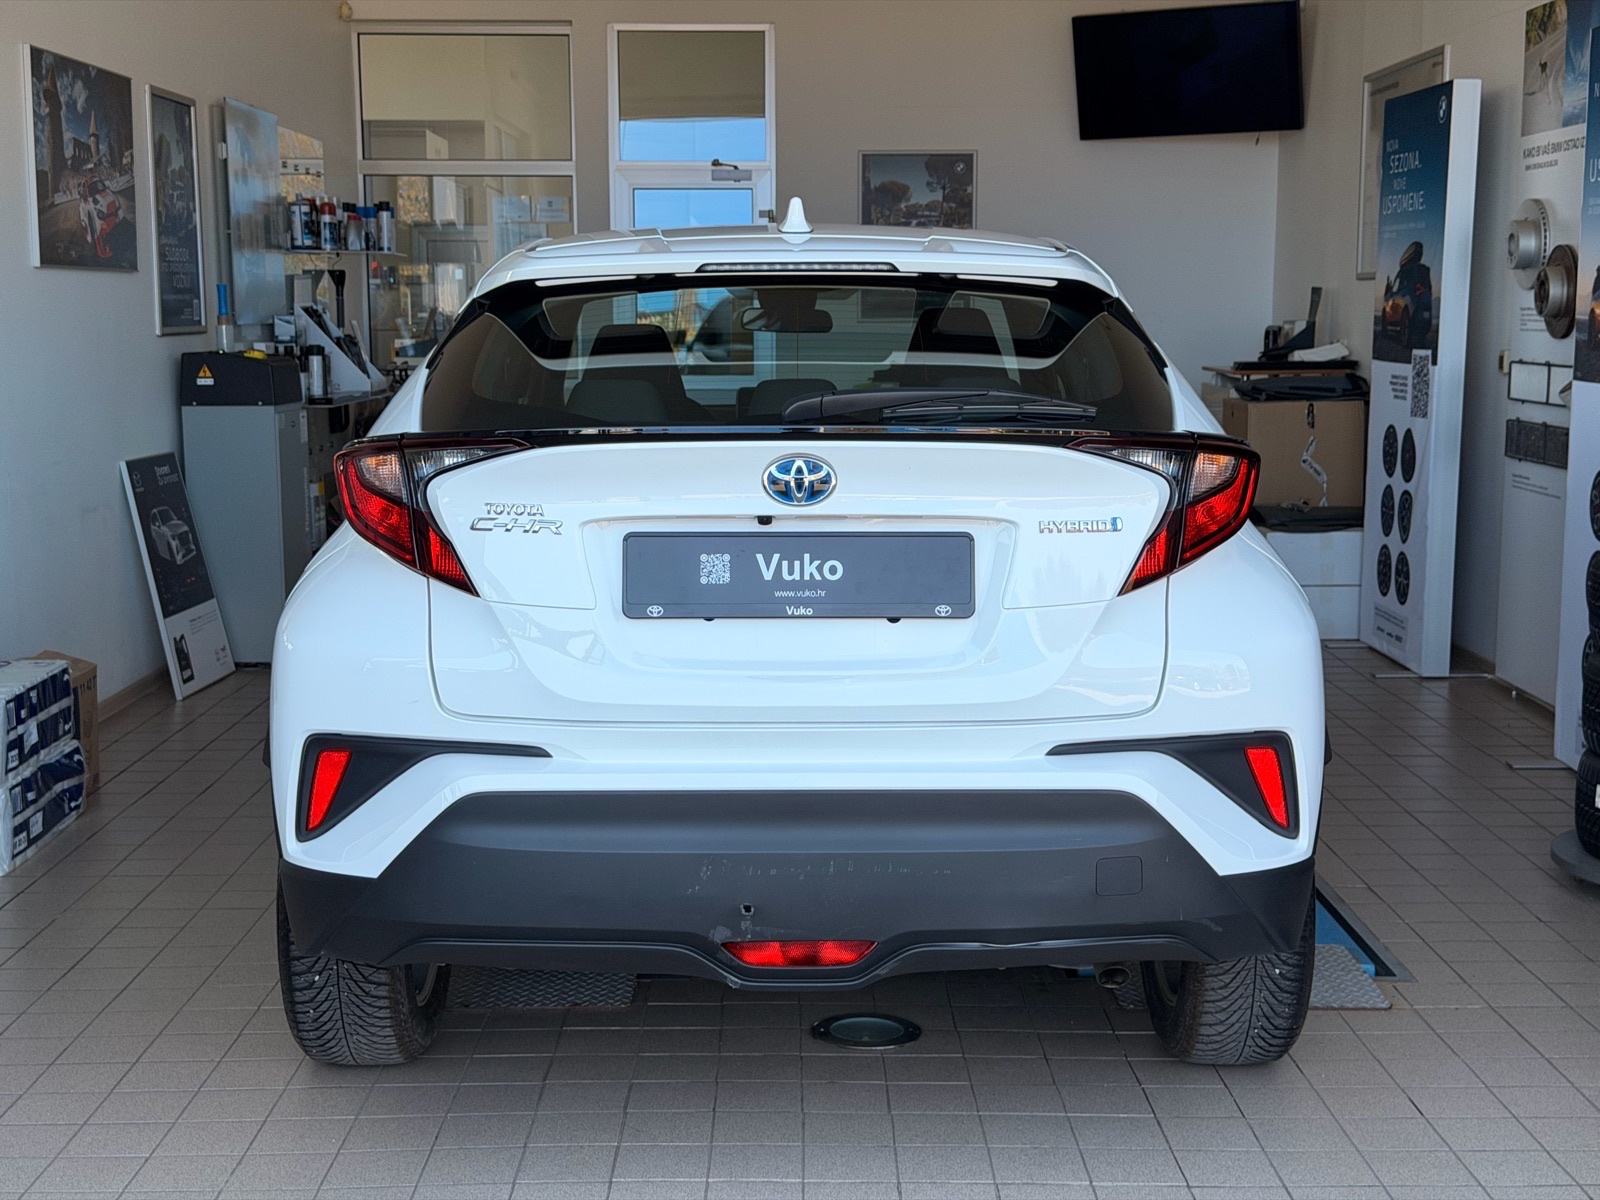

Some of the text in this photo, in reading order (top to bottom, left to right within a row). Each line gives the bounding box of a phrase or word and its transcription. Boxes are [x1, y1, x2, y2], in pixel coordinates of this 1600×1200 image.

[484, 502, 544, 516] TOYOTA
[470, 517, 563, 535] C-HR
[1039, 519, 1111, 534] HYBRID
[756, 553, 844, 581] Vuko
[774, 588, 827, 598] www.vuko.hr
[786, 605, 814, 616] Vuko
